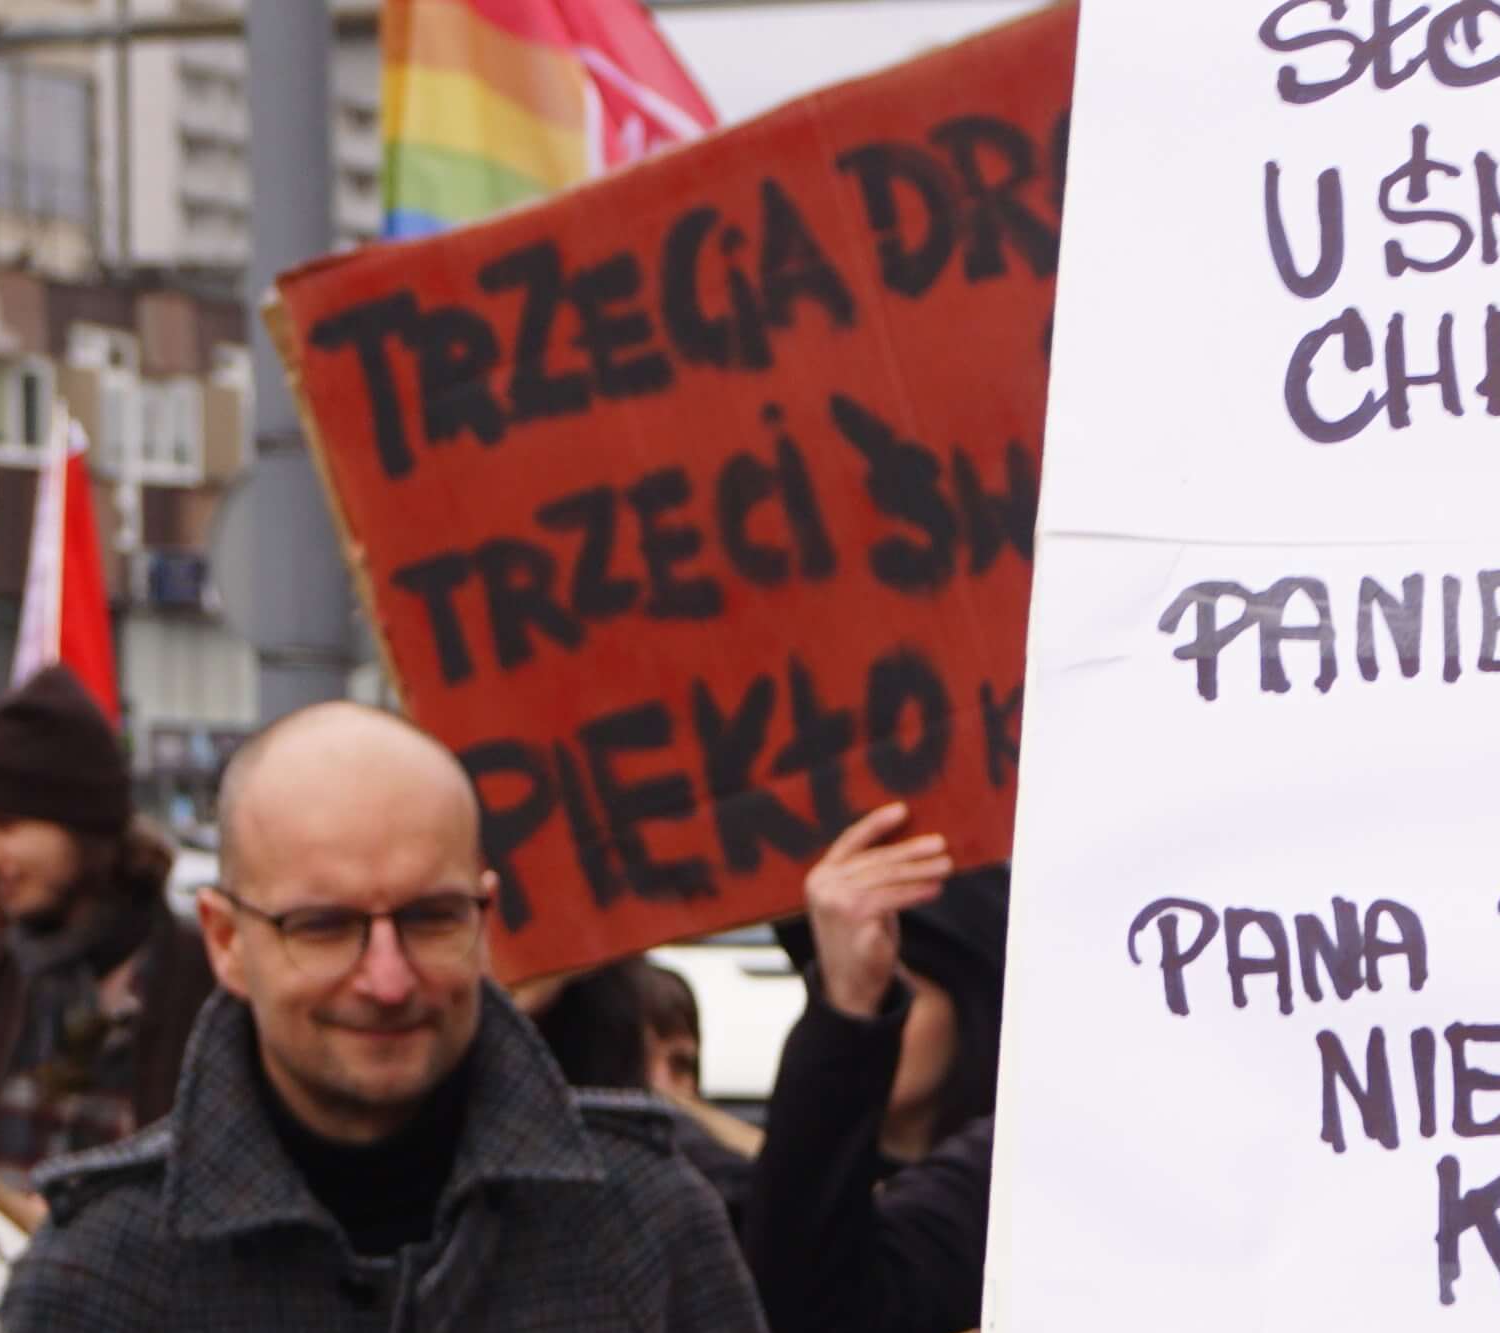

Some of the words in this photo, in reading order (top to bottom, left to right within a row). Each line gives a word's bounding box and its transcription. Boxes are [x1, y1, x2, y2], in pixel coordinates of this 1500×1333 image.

[391, 402, 838, 688] TRZECI
[457, 646, 952, 934] PIEKŁO
[1128, 897, 1428, 1016] PANA
